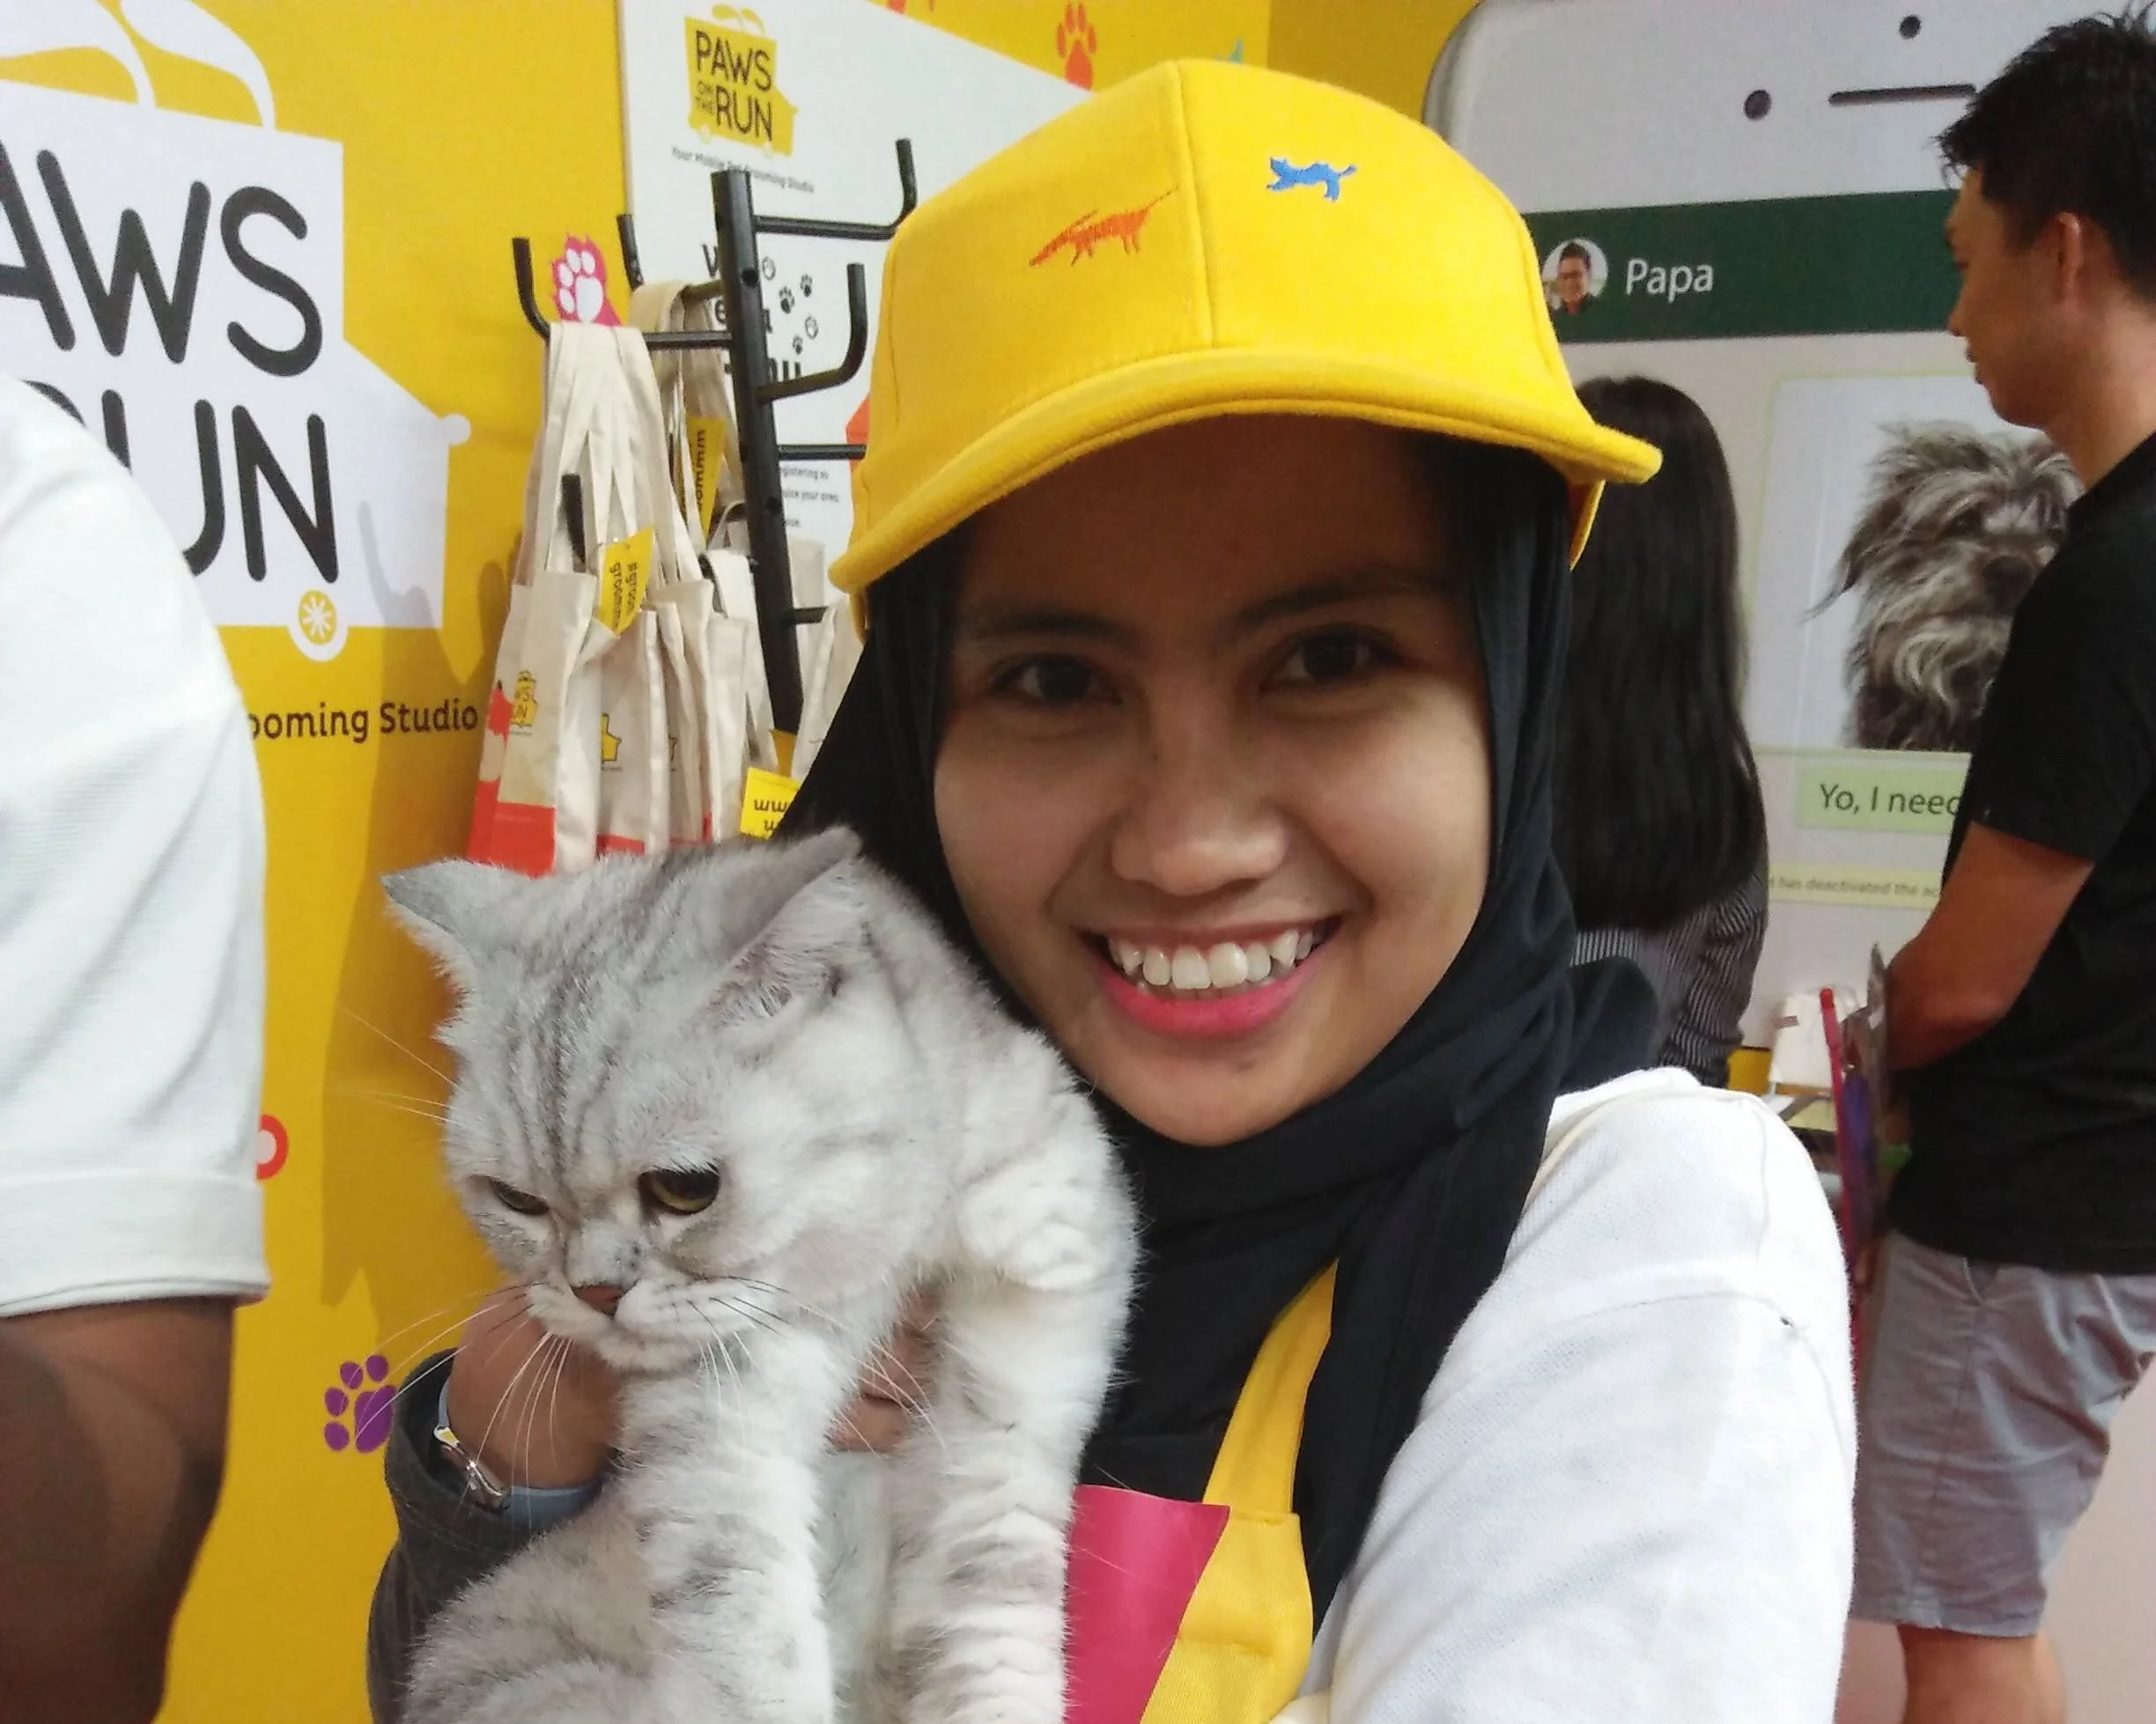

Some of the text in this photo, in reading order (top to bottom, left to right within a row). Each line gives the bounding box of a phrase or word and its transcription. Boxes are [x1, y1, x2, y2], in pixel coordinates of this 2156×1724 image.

[696, 30, 772, 92] PAWS
[716, 85, 772, 141] RUN
[1626, 258, 1714, 304] Papa
[22, 379, 339, 584] UN
[380, 697, 479, 734] Studio
[1820, 783, 1860, 815] Yo,
[1871, 785, 1879, 813] I
